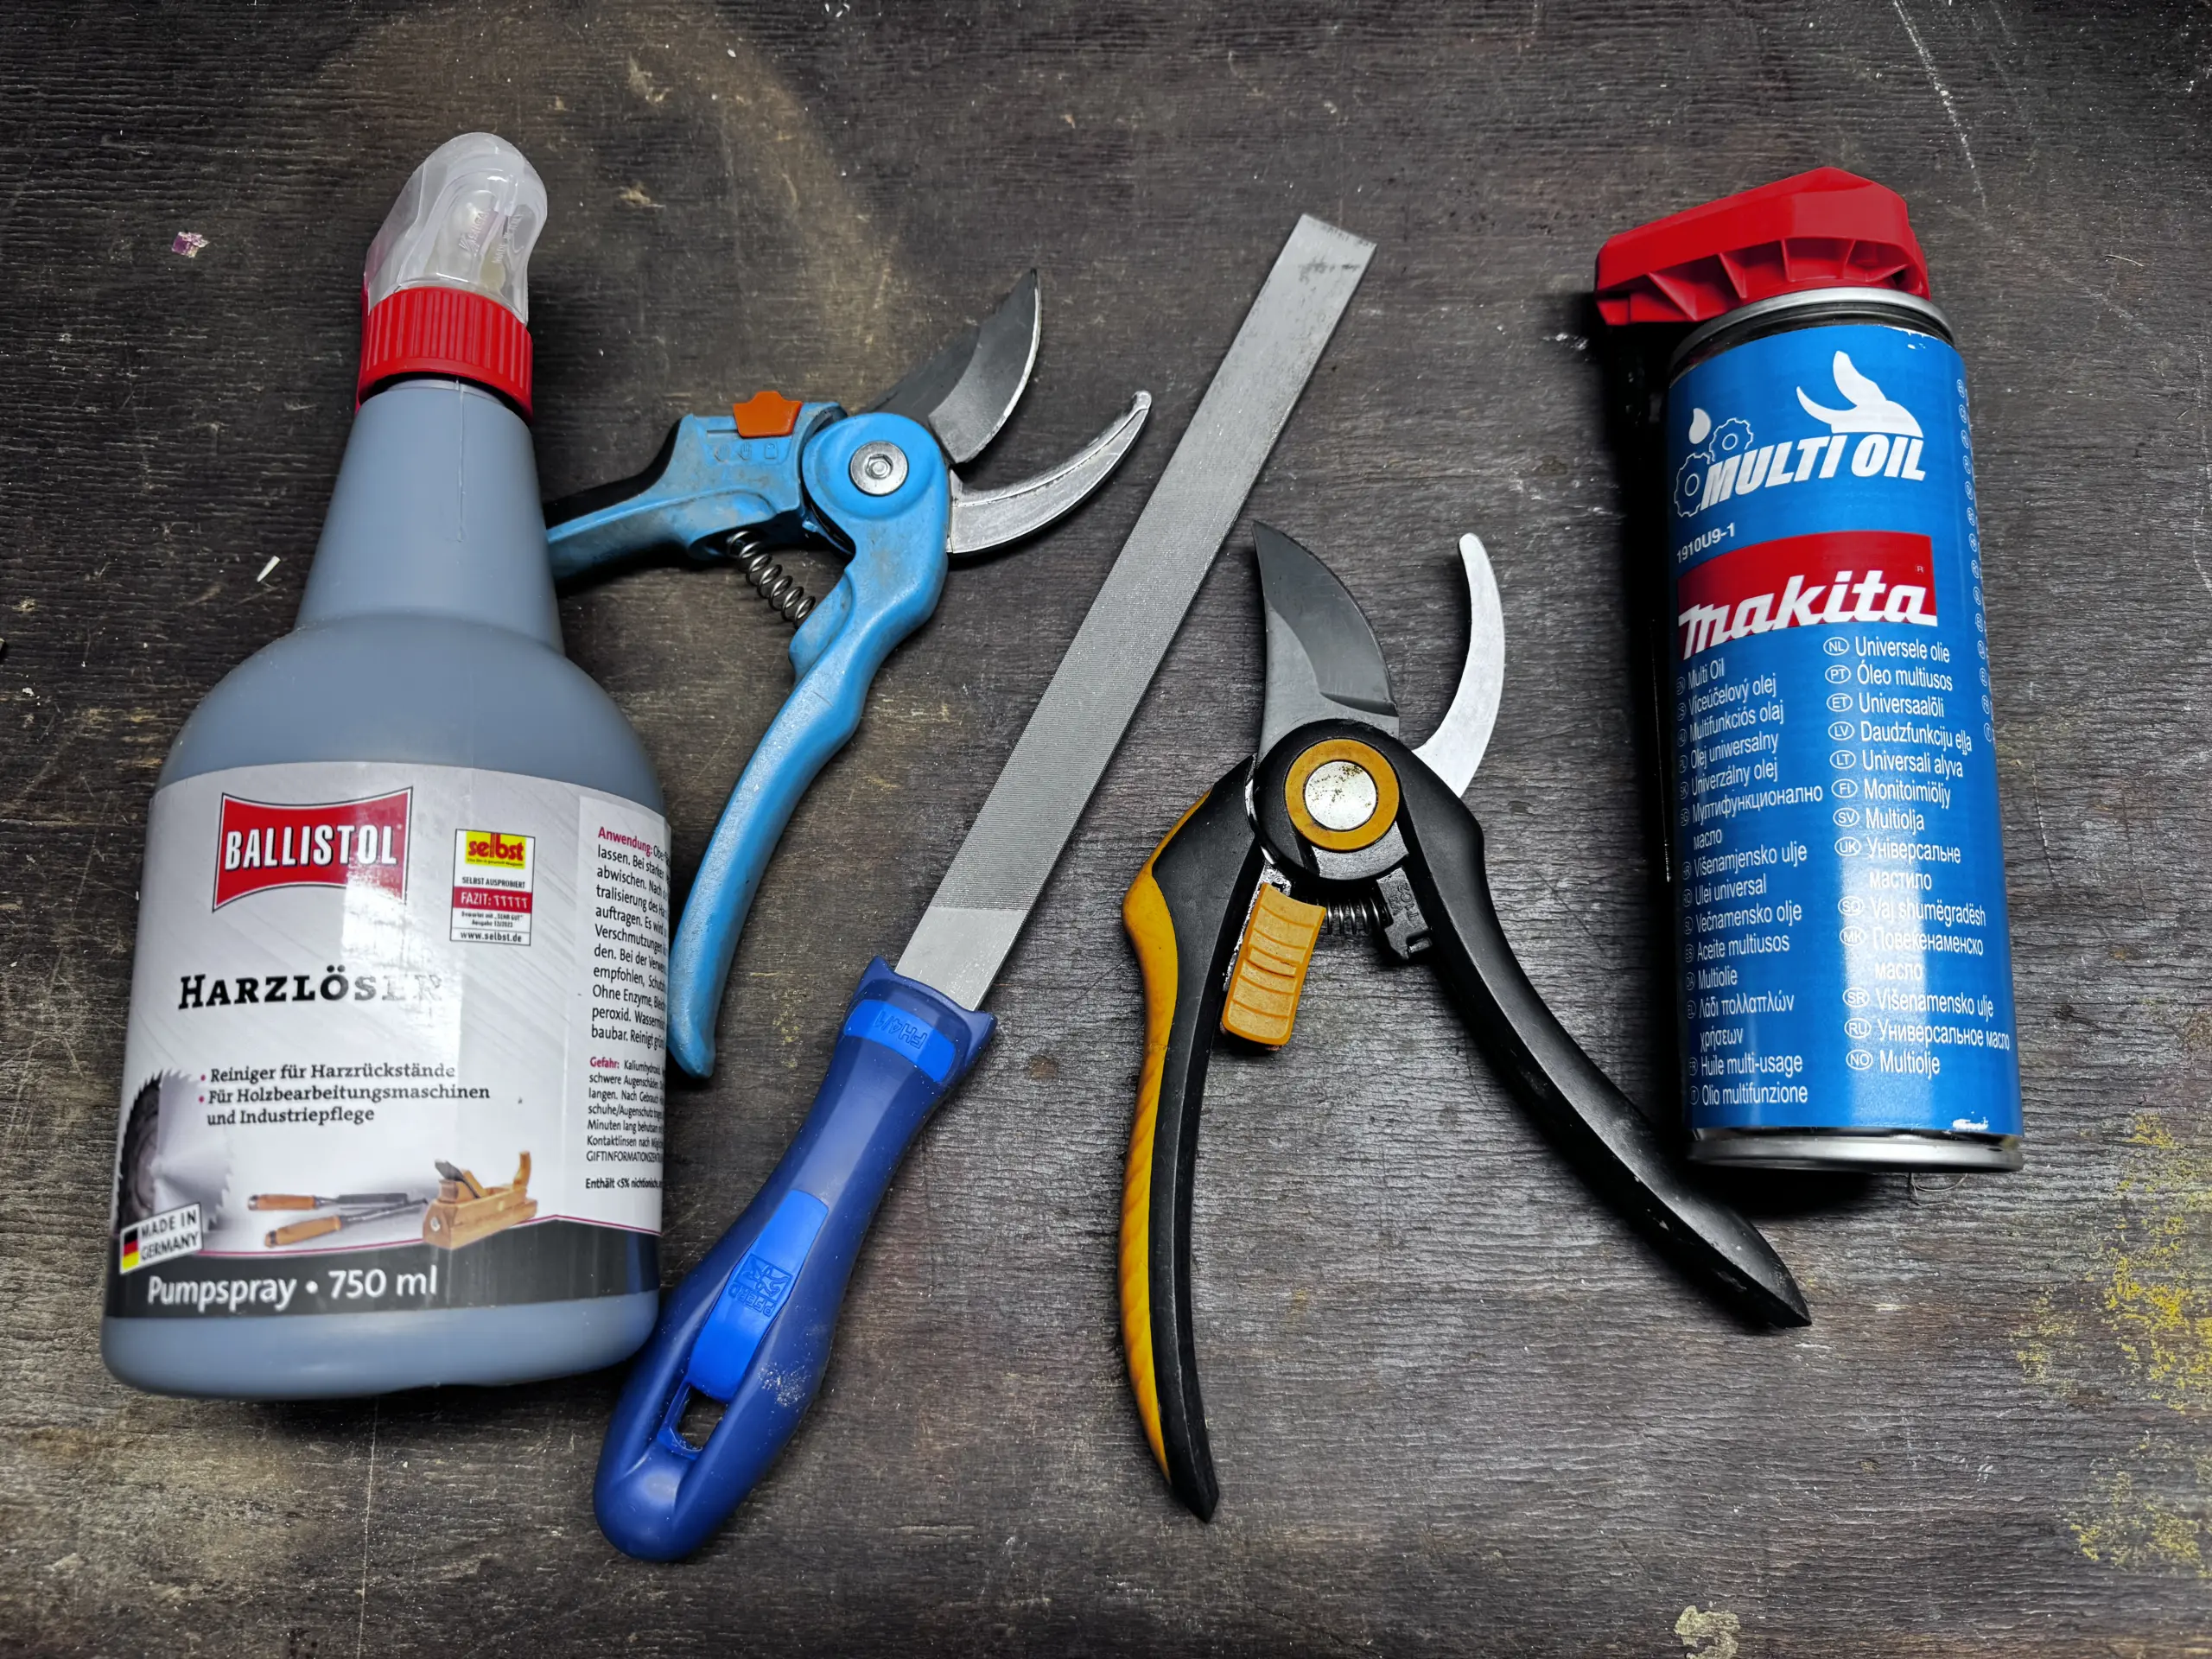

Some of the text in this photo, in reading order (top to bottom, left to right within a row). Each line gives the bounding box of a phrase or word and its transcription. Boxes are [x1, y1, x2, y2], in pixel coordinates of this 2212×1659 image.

[1700, 434, 1926, 511] MULTI OIL
[1676, 523, 1736, 564] 1910U9-1
[1679, 570, 1937, 661] makita
[1855, 636, 1927, 659] Universele
[1931, 645, 1950, 663] olie
[1688, 666, 1708, 690] Multi
[1710, 658, 1725, 680] Oil
[1752, 672, 1777, 698] olej
[1857, 659, 1891, 685] Óleo
[1896, 667, 1953, 691] multiusos
[1859, 692, 1944, 718] Universaalõli
[1689, 707, 1756, 743] Multifunkciós
[1759, 699, 1784, 724] olaj
[1690, 747, 1707, 771] Olej
[1709, 730, 1779, 762] uniwersalny
[1860, 721, 1953, 753] Daudzfunkciju
[1692, 765, 1750, 796] Univerzálny
[1753, 757, 1778, 782] olej
[1862, 750, 1931, 772] Universali
[1935, 754, 1963, 780] alyva
[1864, 779, 1951, 810] Monitoimiöljy
[1866, 807, 1924, 835] Multiolja
[225, 823, 397, 871] BALLISTOL
[468, 833, 524, 861] selbst
[598, 827, 652, 858] Anwendung:
[1694, 828, 1722, 851] масло
[1868, 836, 1961, 863] Універсальне
[598, 844, 631, 866] lassen.
[633, 855, 645, 868] Bei
[1694, 846, 1777, 879] Višenamjensko
[1782, 841, 1808, 867] ulje
[461, 876, 525, 889] SELBST AUSPROBIERT
[597, 865, 646, 890] abwischen.
[649, 880, 662, 896] Nach
[1695, 884, 1712, 906] Ulei
[1713, 874, 1767, 901] universal
[1870, 869, 1932, 891] мастило
[461, 892, 492, 906] FAZIT:
[596, 884, 647, 913] tralisierung
[648, 898, 658, 913] des
[595, 906, 643, 927] auftragen.
[645, 916, 652, 930] Es
[1696, 902, 1772, 933] Večnamensko
[1777, 899, 1802, 927] olje
[1871, 899, 1895, 922] Vaj
[1900, 898, 1986, 928] shumëgradësh
[461, 931, 522, 943] www.selbst.de
[595, 924, 663, 956] Verschmutzungen
[1697, 940, 1726, 962] Aceite
[1728, 933, 1789, 957] multiusos
[1873, 927, 1983, 957] Повекенаменско
[594, 944, 617, 960] den.
[620, 948, 632, 963] Bei
[635, 951, 647, 967] der
[594, 967, 645, 988] empfohlen,
[1698, 966, 1738, 990] Multiolie
[1875, 963, 1923, 982] масло
[592, 984, 620, 1001] Ohne
[623, 988, 653, 1009] Enzyme,
[1699, 997, 1719, 1020] Λάδι
[1721, 990, 1795, 1014] πολλαπλών
[1876, 988, 1974, 1015] Višenamensko
[1977, 994, 1993, 1022] ulje
[592, 1006, 632, 1022] peroxid.
[591, 1024, 628, 1042] baubar.
[631, 1029, 654, 1051] Reinigt
[874, 1010, 928, 1050] FH4/1
[1700, 1027, 1744, 1053] χρήσεων
[1878, 1019, 1984, 1048] Универсальное
[1986, 1030, 2010, 1052] масло
[211, 1062, 455, 1084] Reiniger für Harzrückstände
[589, 1057, 620, 1071] Gefahr:
[1700, 1057, 1724, 1077] Huile
[1727, 1052, 1802, 1078] multi-usage
[1879, 1050, 1940, 1080] Multiolje
[588, 1072, 622, 1086] schwere
[1701, 1084, 1719, 1106] Olio
[1722, 1080, 1808, 1105] multifunzione
[208, 1084, 490, 1105] Für Holzbearbeitungsmaschinen
[588, 1087, 619, 1103] langen.
[621, 1090, 637, 1102] Nach
[207, 1105, 374, 1126] und Industriepflege
[588, 1119, 621, 1131] Minuten
[623, 1120, 637, 1135] lang
[588, 1135, 637, 1147] Kontaktlinsen
[639, 1136, 650, 1147] nach
[586, 1177, 614, 1189] Enthält
[616, 1177, 630, 1189] <5%
[141, 1210, 197, 1239] MADE IN
[140, 1232, 200, 1263] GERMANY
[148, 1265, 437, 1313] Pumpspray 750 ml
